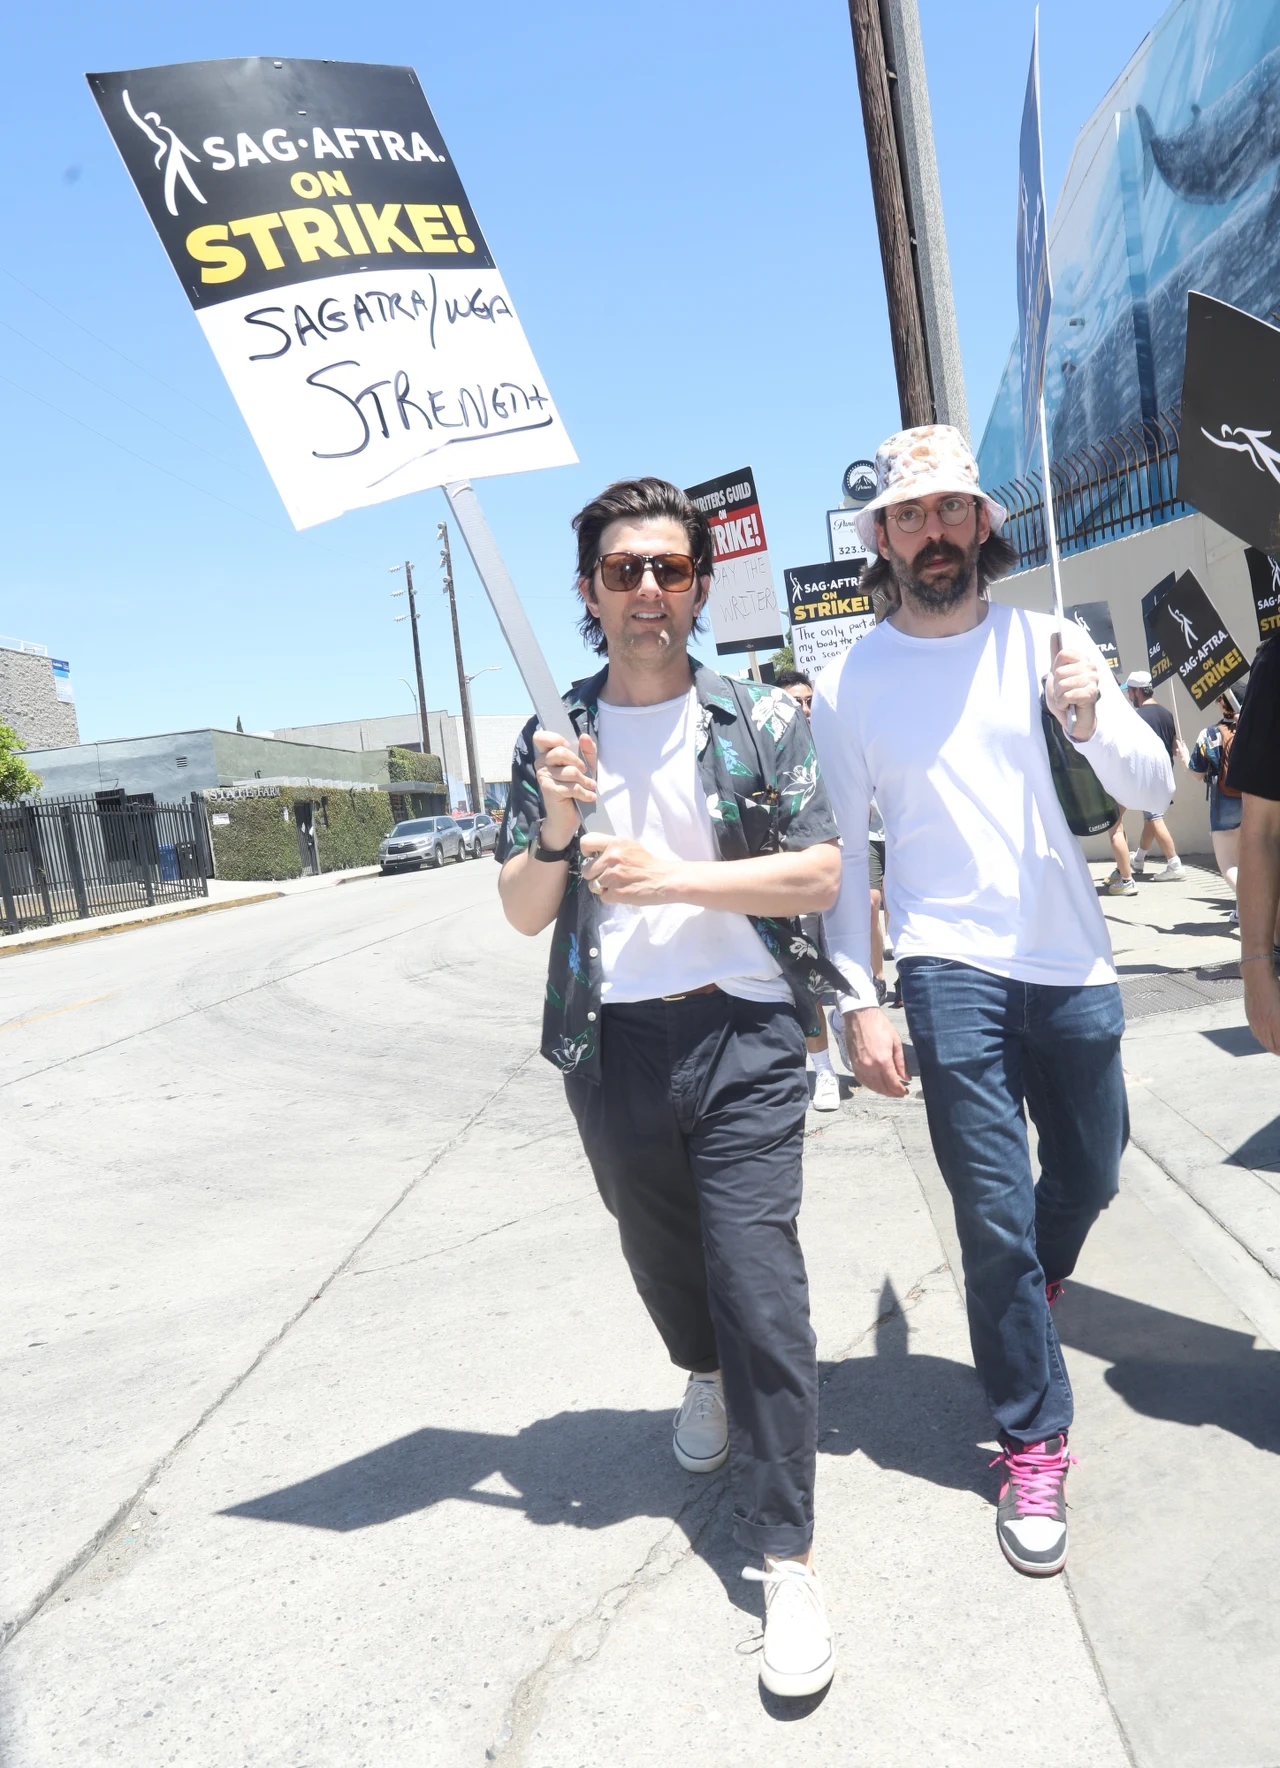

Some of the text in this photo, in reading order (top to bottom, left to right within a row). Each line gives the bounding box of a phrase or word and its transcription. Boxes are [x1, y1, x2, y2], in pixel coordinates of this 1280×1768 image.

[290, 170, 352, 199] ON
[186, 203, 476, 284] STRIKE!
[725, 482, 752, 503] GUILD
[718, 508, 727, 520] ON
[708, 512, 762, 556] TRIKE!
[839, 544, 870, 555] 323.9
[712, 557, 766, 591] PAY THE
[822, 591, 837, 600] ON
[794, 596, 870, 621] STRIKE!
[795, 625, 815, 640] The
[821, 625, 844, 637] only
[849, 618, 867, 634] part
[817, 640, 837, 648] body
[840, 637, 852, 645] the
[1191, 648, 1242, 699] STRIKE!
[1202, 657, 1214, 670] ON
[210, 787, 254, 801] STATE
